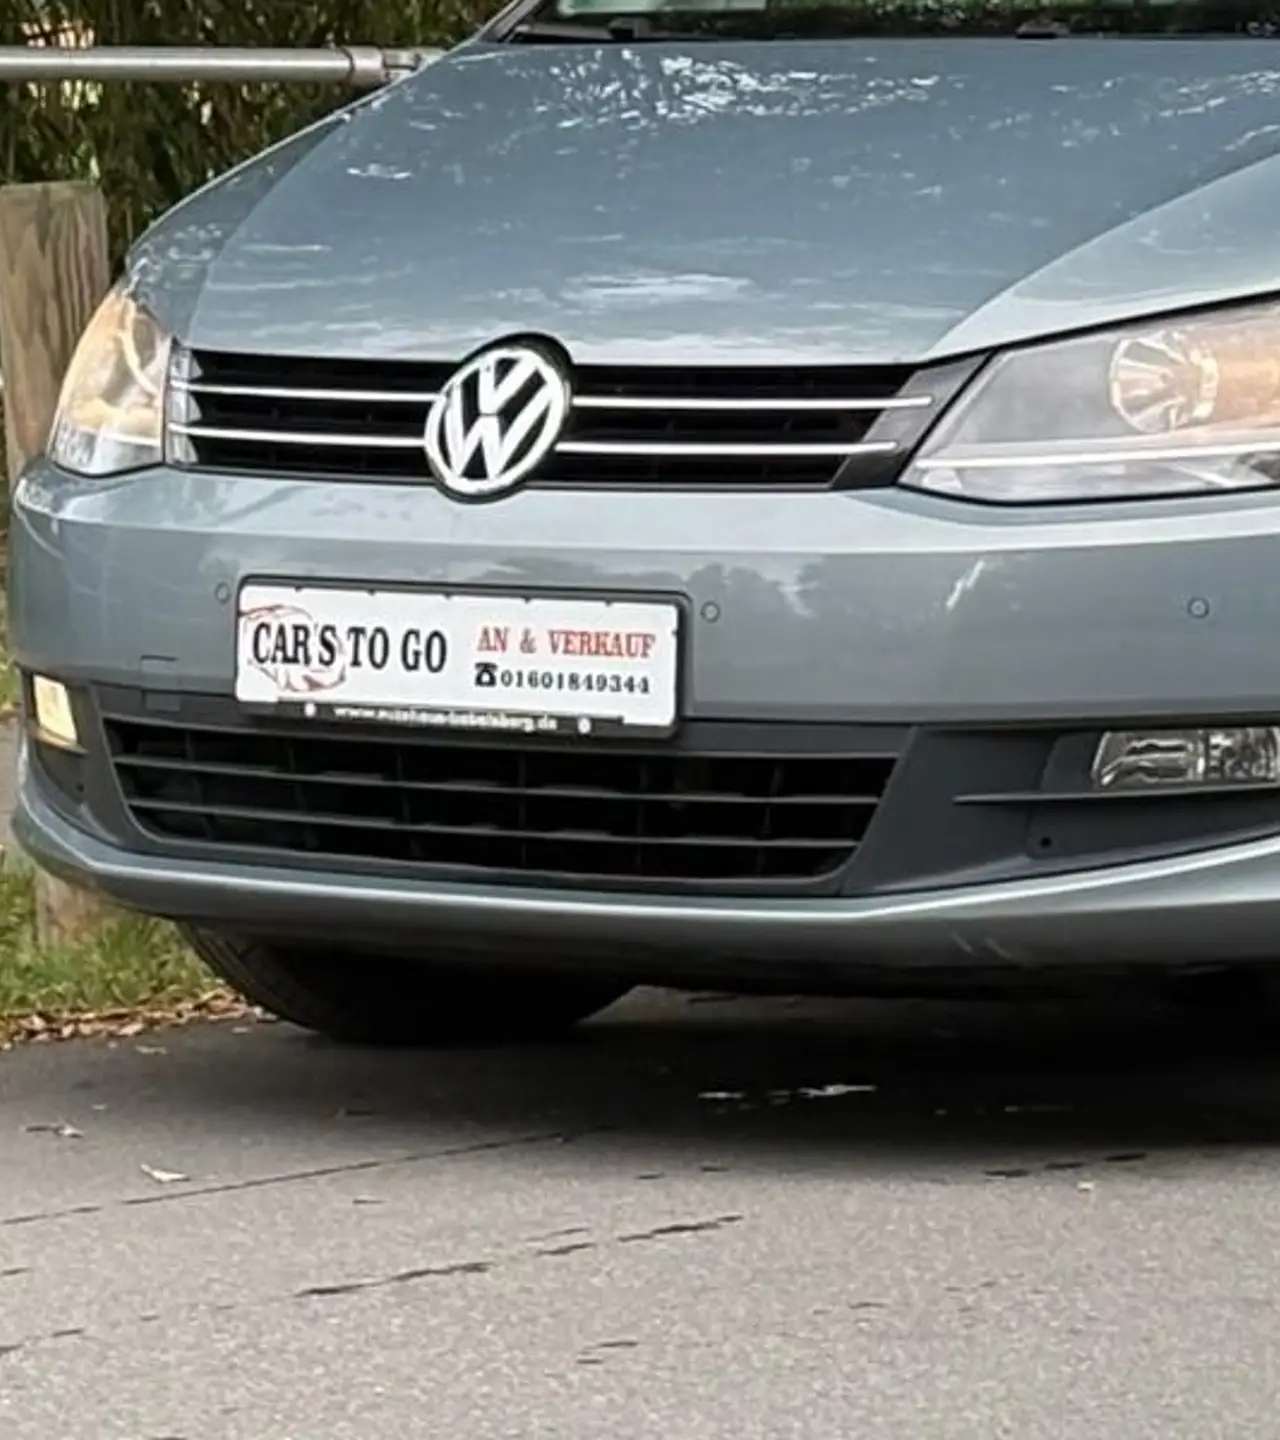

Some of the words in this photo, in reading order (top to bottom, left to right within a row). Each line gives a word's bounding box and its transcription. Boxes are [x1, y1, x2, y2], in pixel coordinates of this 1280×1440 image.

[433, 351, 560, 488] VW
[347, 626, 390, 669] TO
[400, 628, 448, 673] GO
[477, 626, 509, 653] AN
[520, 628, 536, 654] &
[547, 629, 656, 658] VERKAUF
